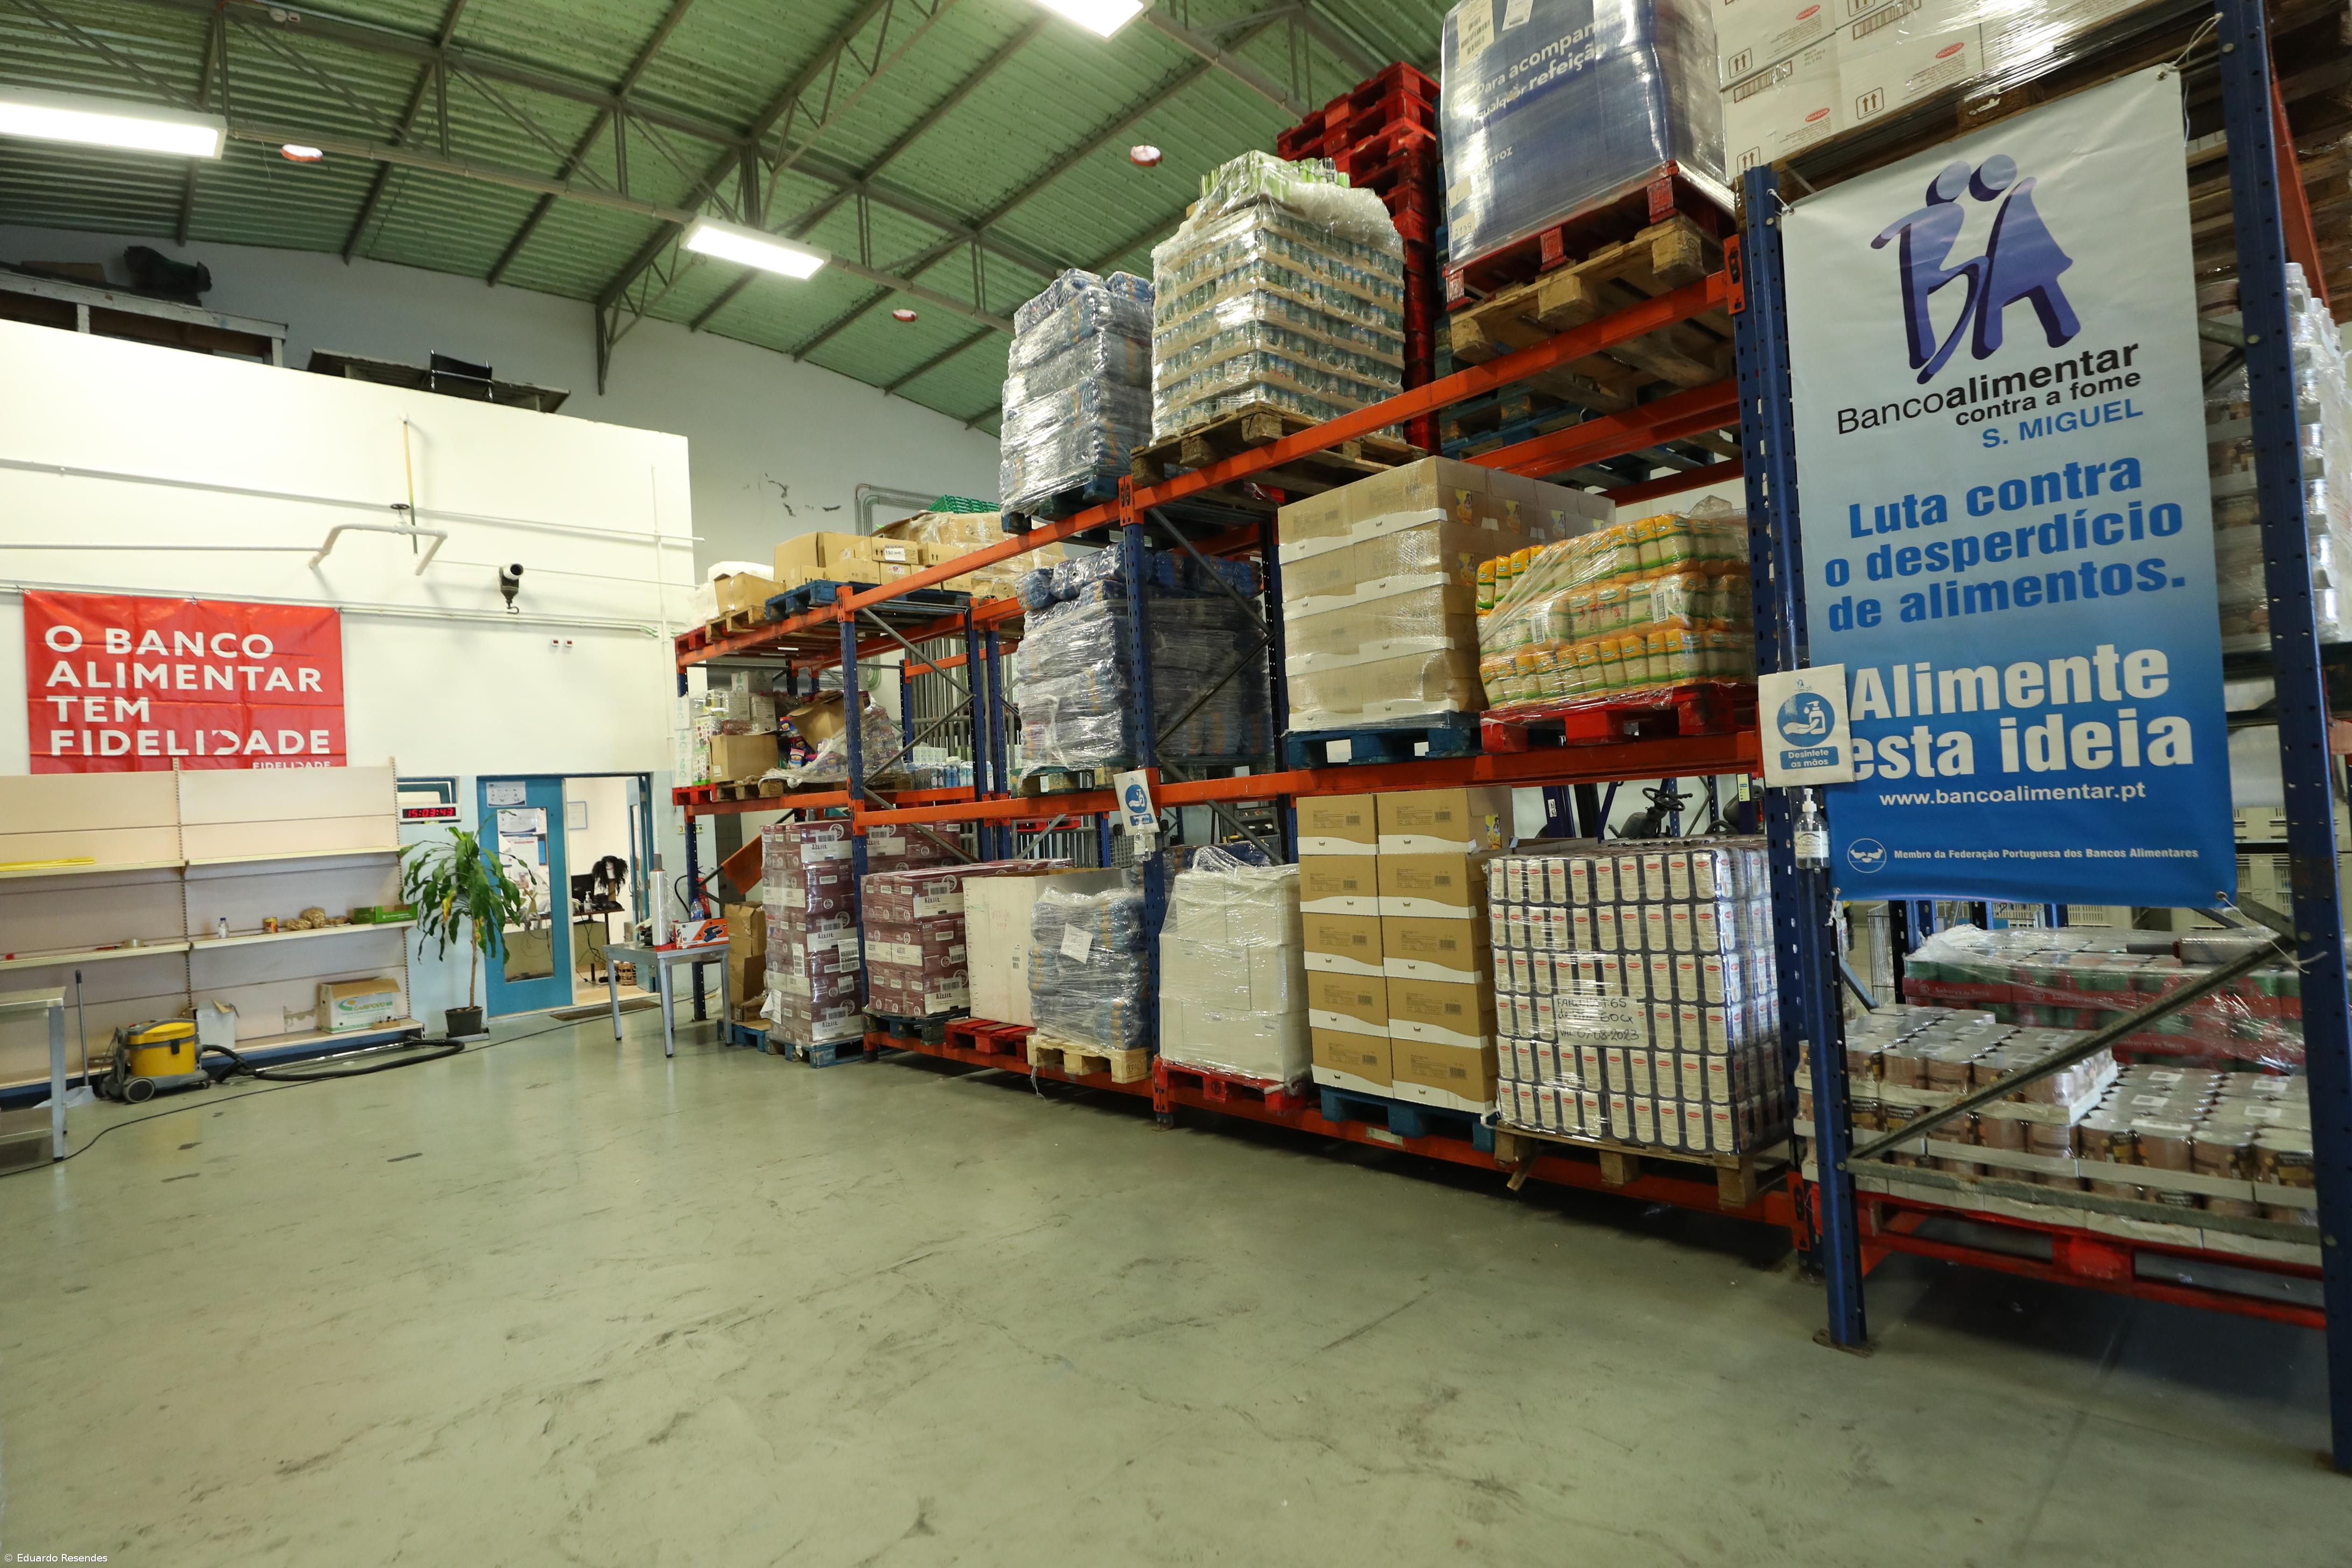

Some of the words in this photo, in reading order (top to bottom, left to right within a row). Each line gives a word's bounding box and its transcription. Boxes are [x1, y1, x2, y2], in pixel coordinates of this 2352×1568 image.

[1529, 43, 1608, 89] refeição
[1837, 342, 2140, 435] Bancoalimentar
[1955, 395, 2037, 426] contra
[2046, 390, 2062, 405] a
[2070, 371, 2141, 400] fome
[1982, 427, 2009, 449] S.
[2019, 398, 2144, 454] MIGUEL
[1849, 494, 1948, 538] Luta
[1966, 457, 2142, 518] contra
[1824, 556, 1850, 588] o
[1866, 500, 2183, 582] desperdício
[1828, 595, 1881, 632] de
[1900, 557, 2186, 623] alimentos.
[45, 625, 82, 653] O
[105, 628, 274, 660] BANCO
[46, 661, 324, 693] ALIMENTAR
[1850, 644, 2169, 722] Alimente
[47, 696, 150, 723] TEM
[51, 729, 330, 757] FIDELIDADE
[1788, 748, 1829, 759] Desinfete
[1791, 760, 1802, 768] as
[1803, 758, 1829, 767] mãos
[1851, 725, 1975, 781] esta
[1999, 708, 2194, 773] ideia
[408, 808, 454, 817] 15:03:43
[1879, 782, 2146, 807] www.bancoalimentar.pt
[1894, 850, 1932, 858] Membro
[1934, 850, 1947, 858] da
[1949, 850, 1999, 860] Federação
[2002, 849, 2061, 860] Portuguesa
[2064, 849, 2083, 858] dos
[2085, 848, 2126, 858] Bancos
[2130, 848, 2199, 858] Alimentares
